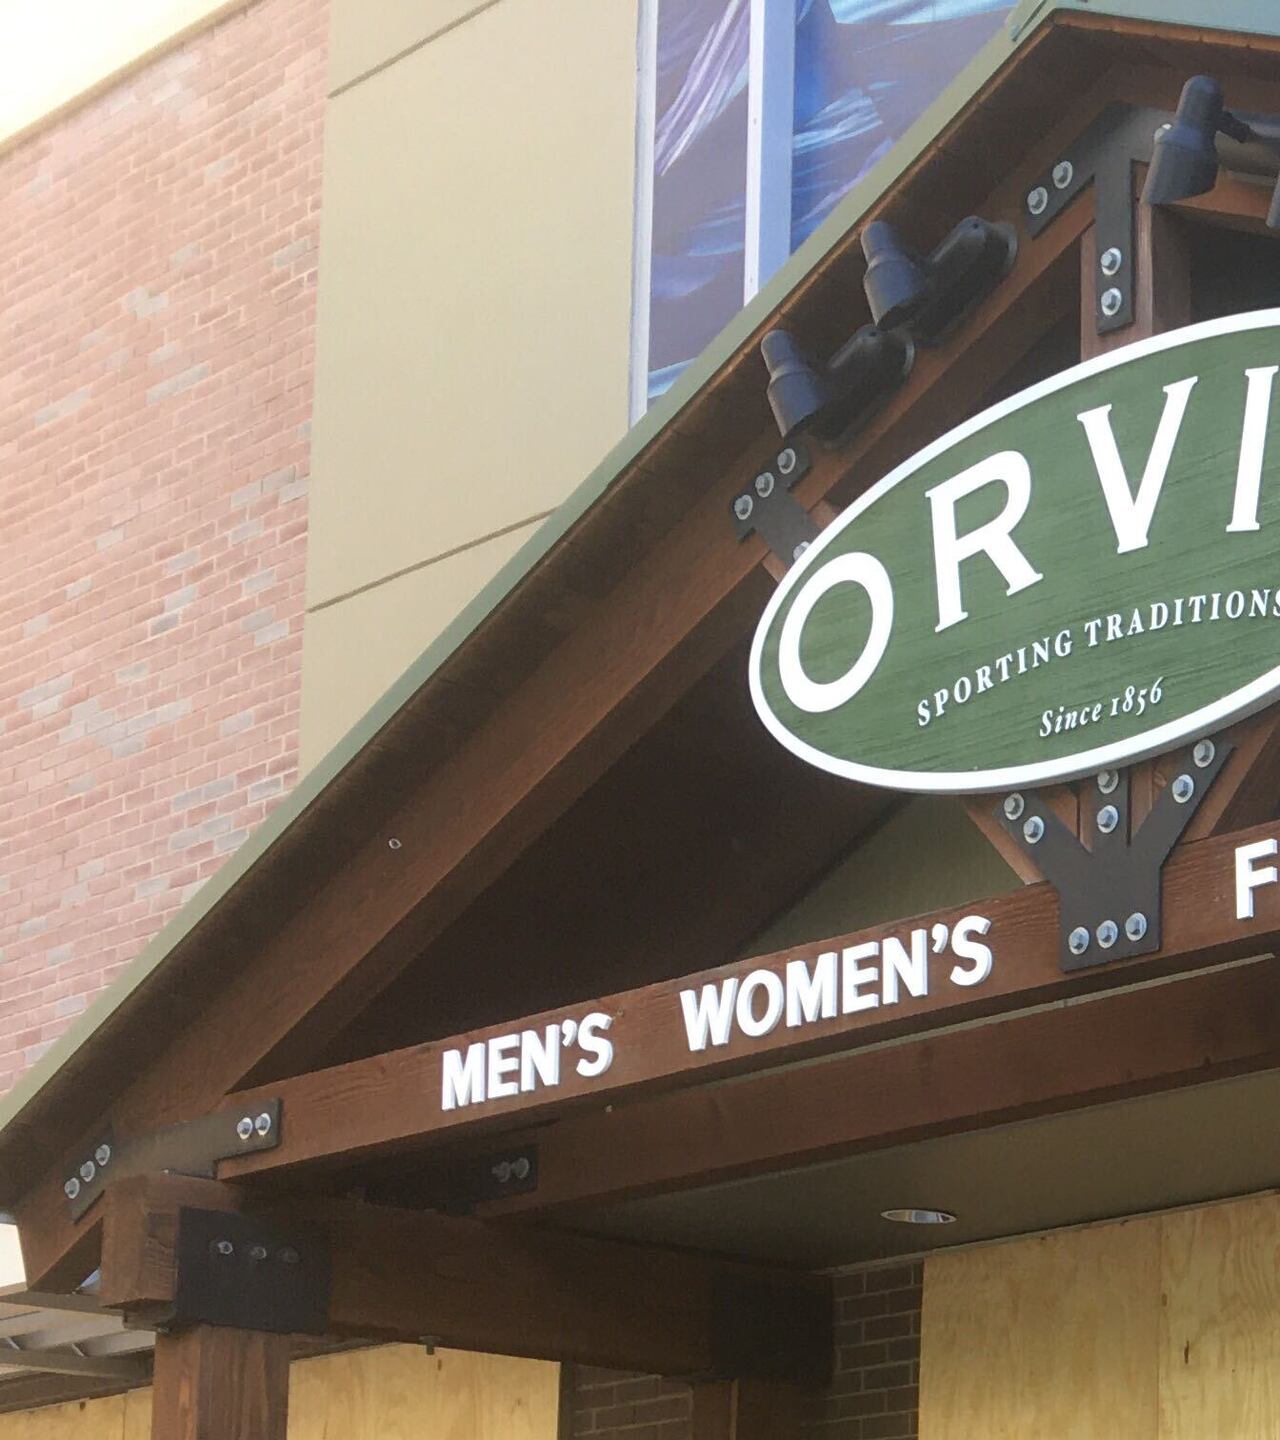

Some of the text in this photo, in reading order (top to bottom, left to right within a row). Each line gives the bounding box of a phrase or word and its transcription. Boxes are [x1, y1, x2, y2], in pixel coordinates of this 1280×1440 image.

[916, 629, 1074, 728] SPORTING
[1038, 676, 1165, 738] Since 1856
[441, 914, 993, 1112] MEN'S WOMEN'S
